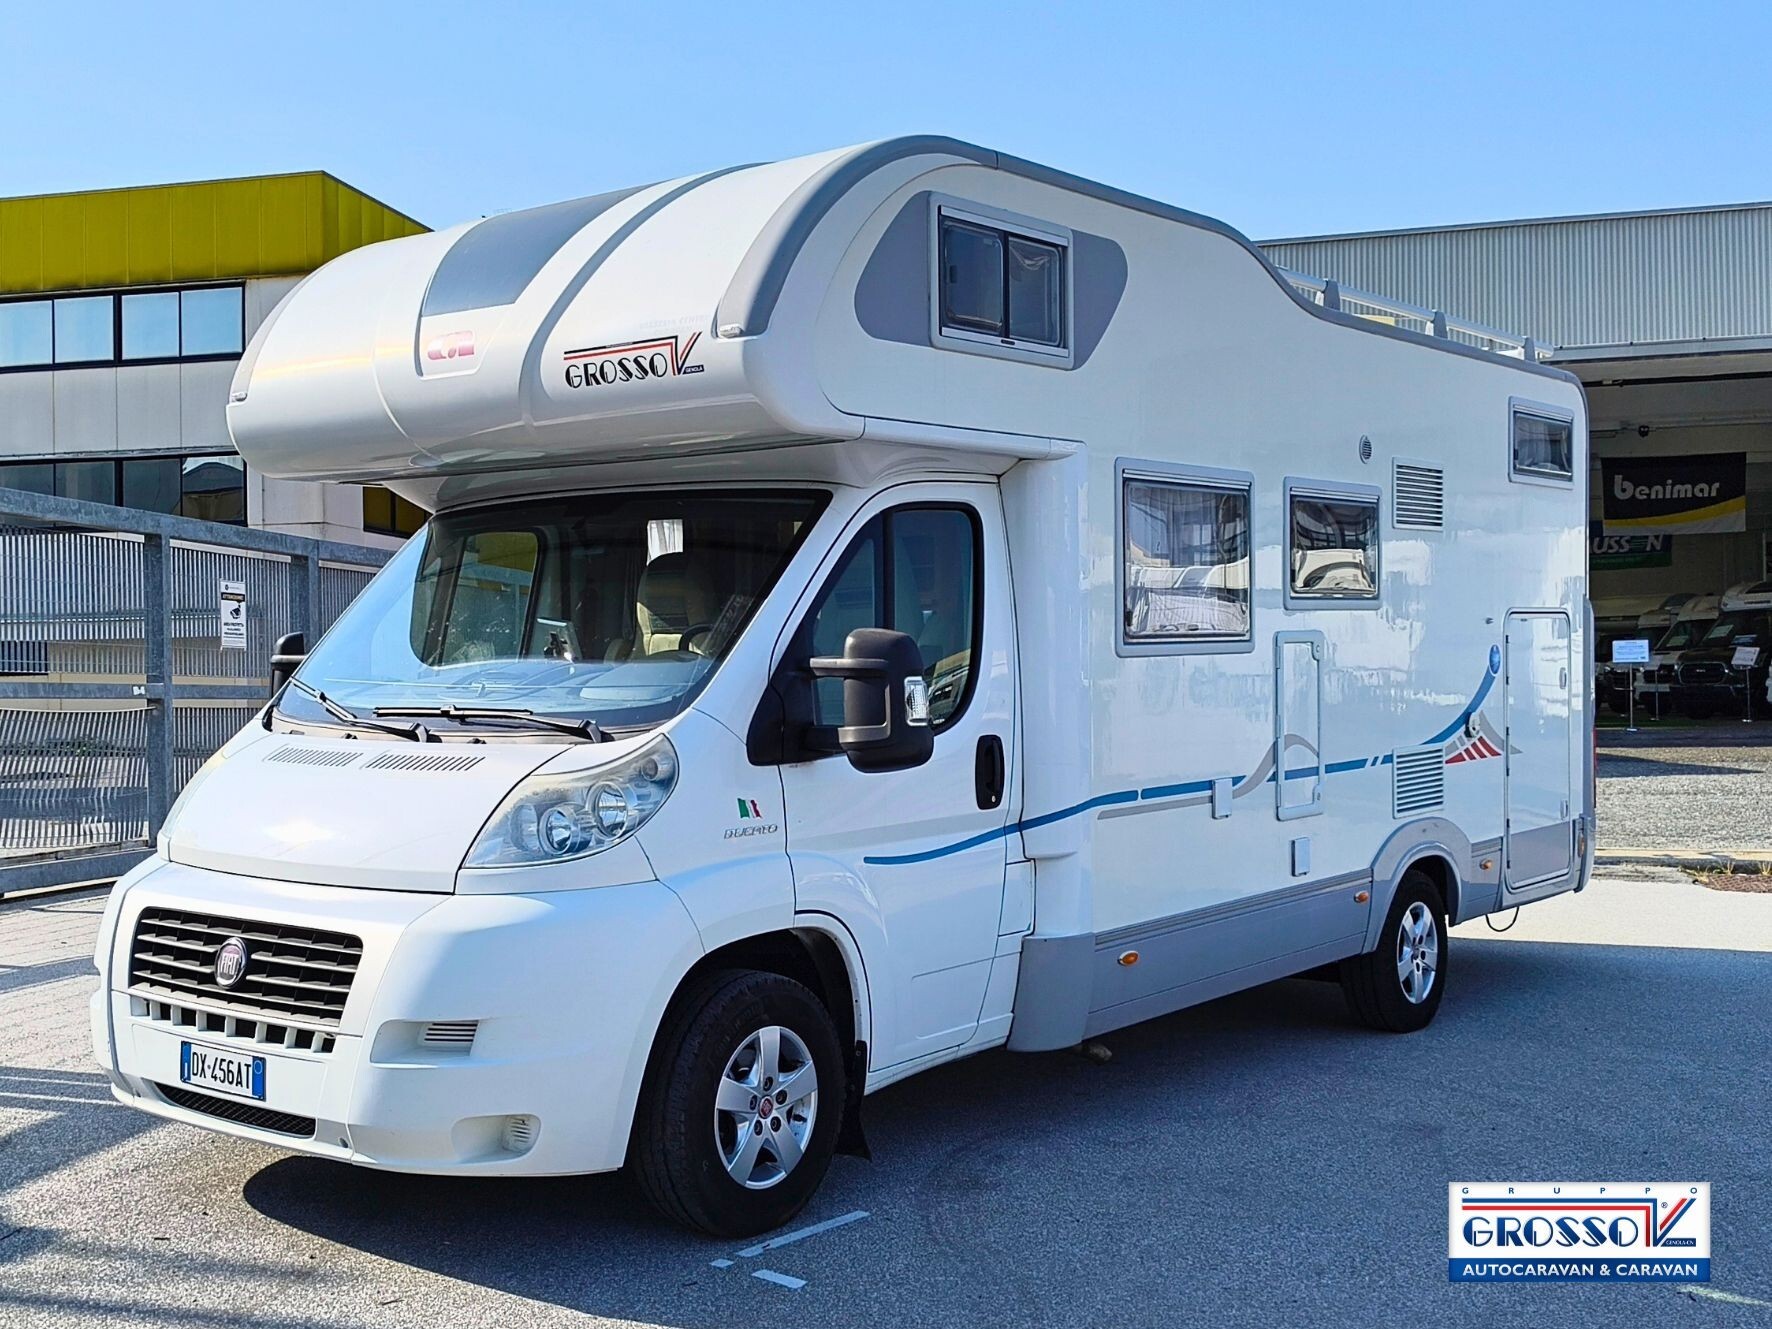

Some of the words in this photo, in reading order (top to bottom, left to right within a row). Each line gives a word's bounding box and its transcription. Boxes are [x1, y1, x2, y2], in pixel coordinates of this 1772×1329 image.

[565, 352, 668, 389] GROSSO
[1613, 475, 1720, 500] benimar
[220, 953, 240, 975] FIAT
